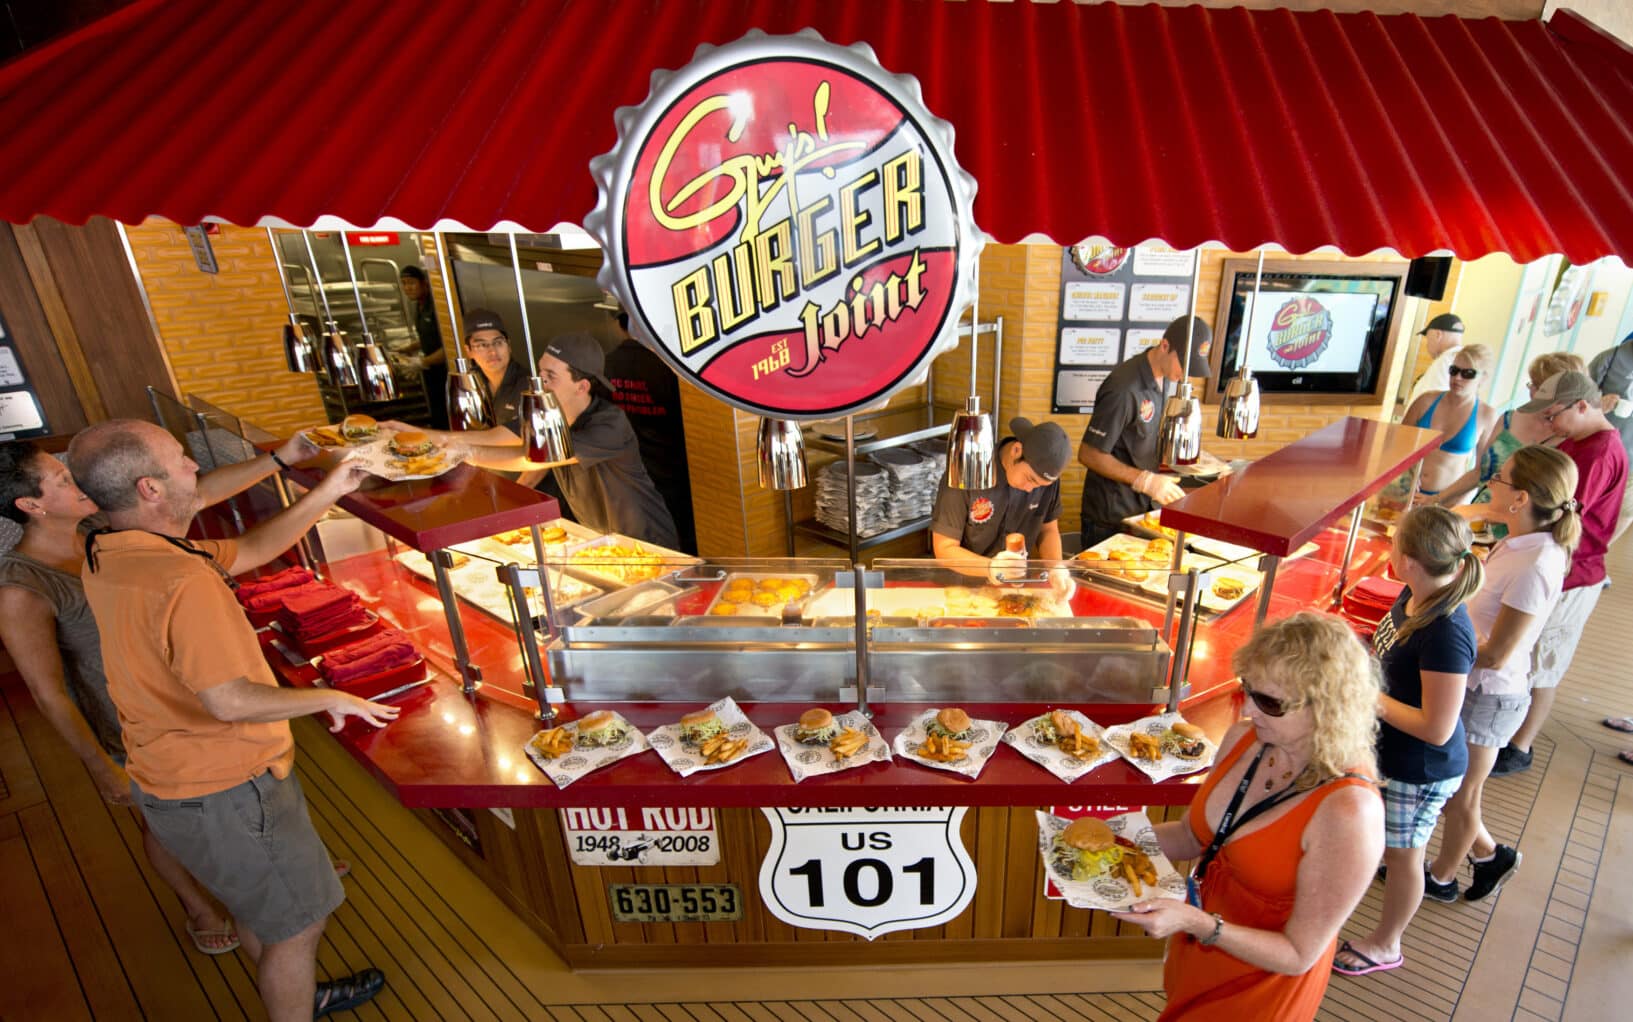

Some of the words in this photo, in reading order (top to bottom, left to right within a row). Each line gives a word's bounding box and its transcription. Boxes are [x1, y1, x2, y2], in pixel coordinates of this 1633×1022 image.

[649, 80, 868, 243] Guy's!
[671, 146, 926, 356] BURGER
[785, 248, 928, 377] Joint
[771, 337, 788, 354] EST
[751, 348, 790, 381] 1968
[575, 835, 620, 852] 1948
[660, 835, 710, 852] 2008
[841, 831, 893, 851] US
[789, 857, 935, 907] 101
[616, 888, 736, 914] 630-553
